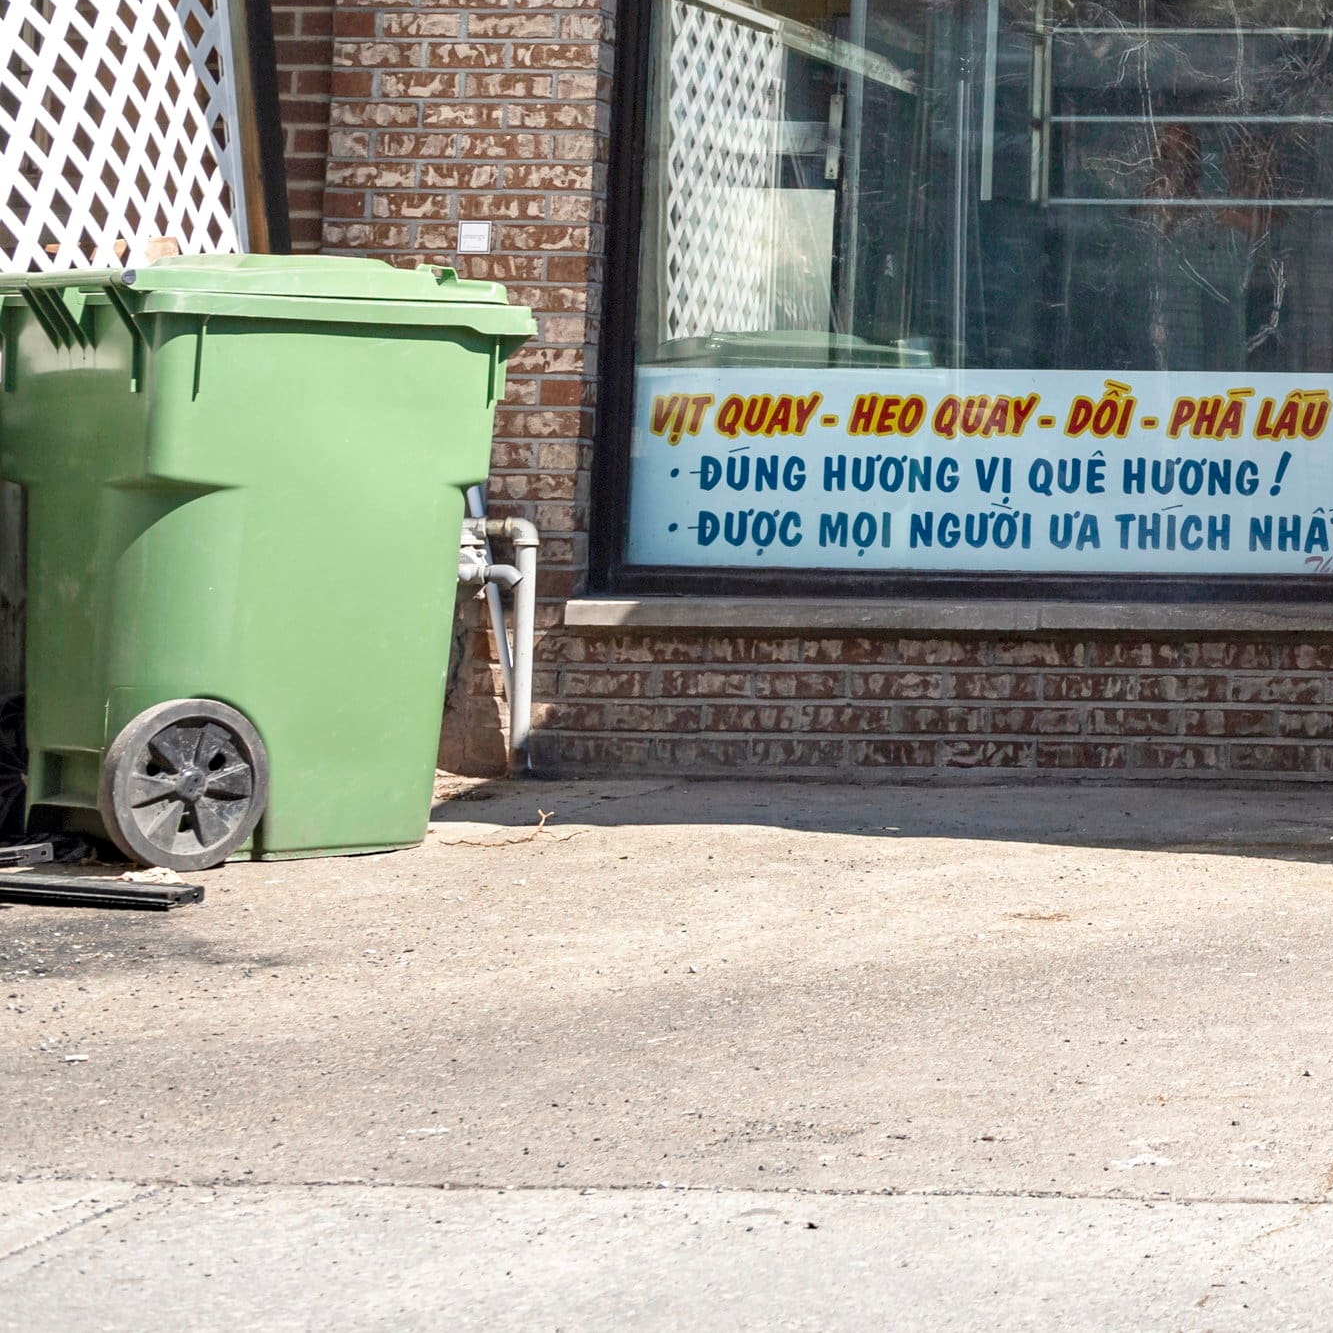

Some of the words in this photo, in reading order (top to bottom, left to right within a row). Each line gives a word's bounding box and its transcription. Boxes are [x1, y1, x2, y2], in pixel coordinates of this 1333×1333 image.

[651, 393, 716, 445] VỊT
[716, 391, 823, 438] QUAY
[847, 393, 927, 437] HEO
[932, 392, 1040, 439] QUAY
[690, 447, 807, 492] ĐÚNG
[824, 453, 959, 493] HƯƠNG
[976, 457, 1012, 504] VỊ
[1028, 450, 1106, 496] QUÊ
[688, 508, 803, 556] ĐƯỢC
[819, 512, 891, 557] MỌI
[910, 502, 1031, 549] NGƯỜI
[1049, 511, 1101, 550] ƯA
[1115, 505, 1231, 552] THÍCH
